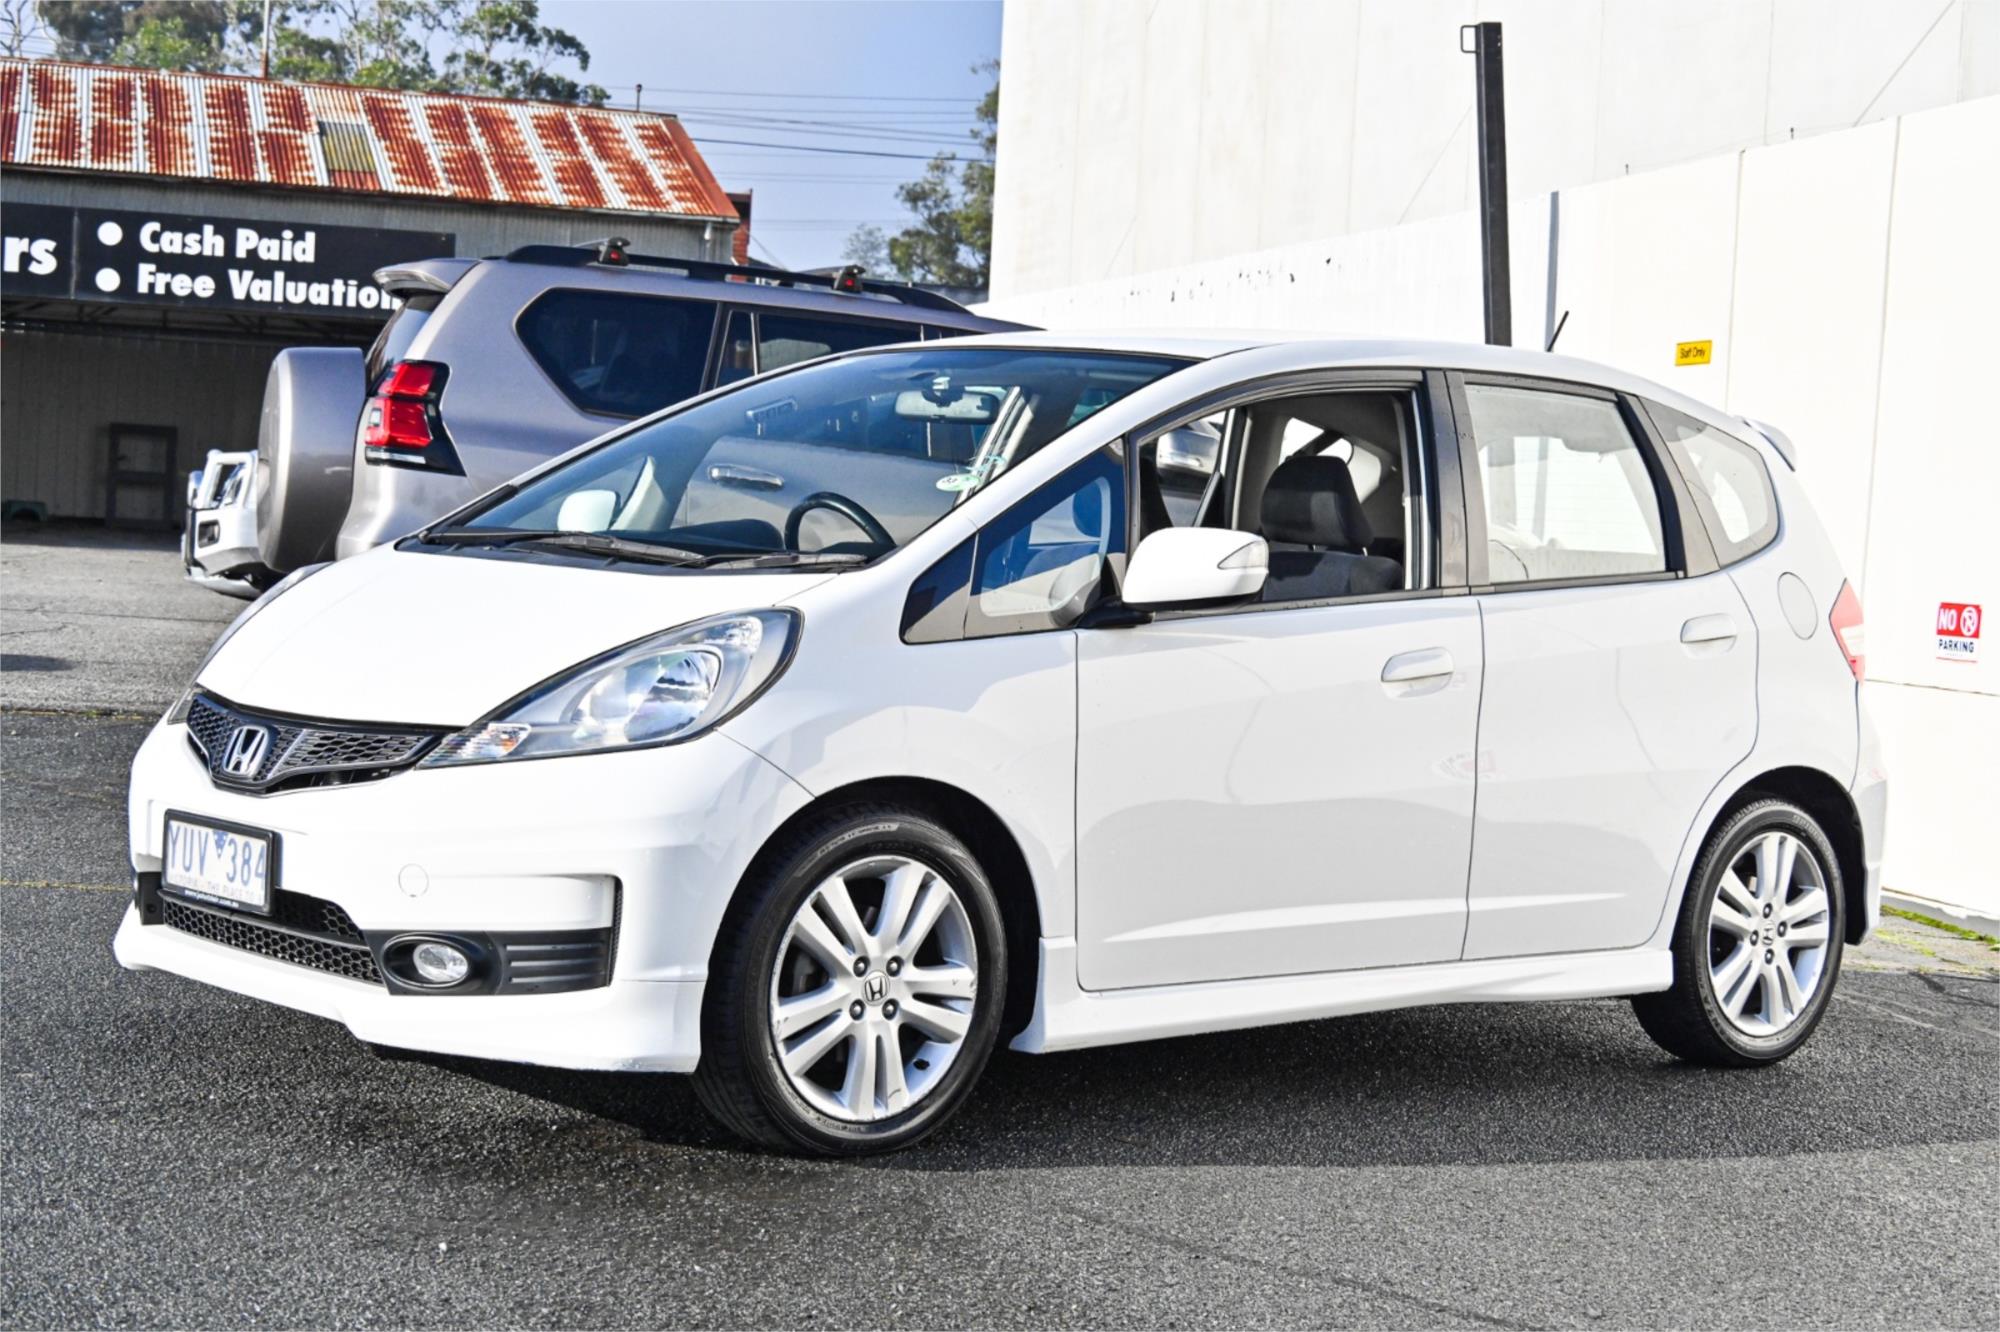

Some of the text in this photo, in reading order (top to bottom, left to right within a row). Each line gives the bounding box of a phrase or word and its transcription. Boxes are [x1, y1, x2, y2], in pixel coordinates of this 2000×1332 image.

[139, 220, 316, 264] Cash Paid
[136, 262, 217, 298] Free
[1938, 607, 1958, 632] NO
[1938, 638, 1975, 653] PARKING
[168, 822, 209, 877] YUV
[226, 837, 266, 893] 384
